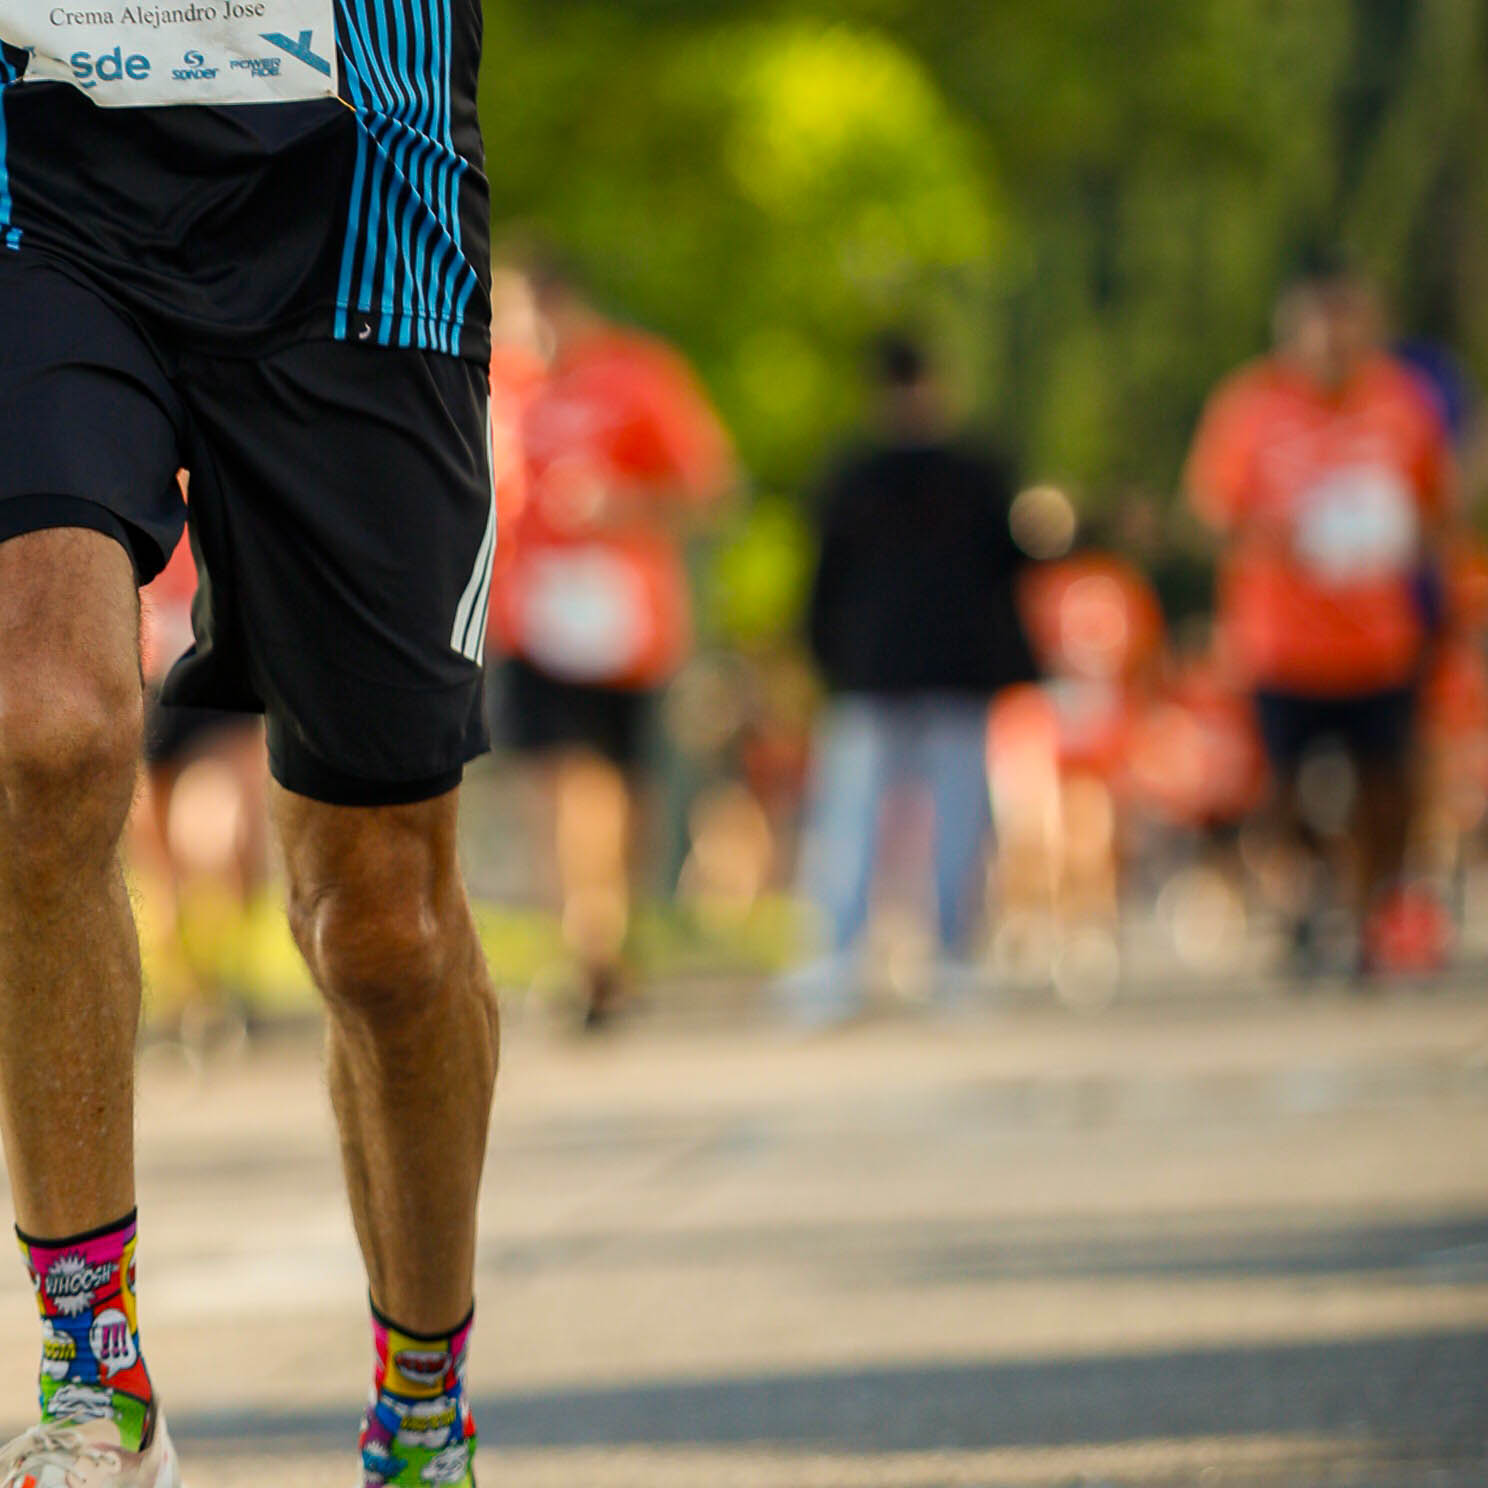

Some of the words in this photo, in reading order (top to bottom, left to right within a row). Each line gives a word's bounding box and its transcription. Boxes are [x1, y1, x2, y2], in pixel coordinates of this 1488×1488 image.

[49, 6, 114, 27] Crema
[120, 2, 217, 29] Alejandro
[222, 0, 266, 20] Jose
[69, 46, 152, 82] sde
[45, 1263, 112, 1297] WHOOSH
